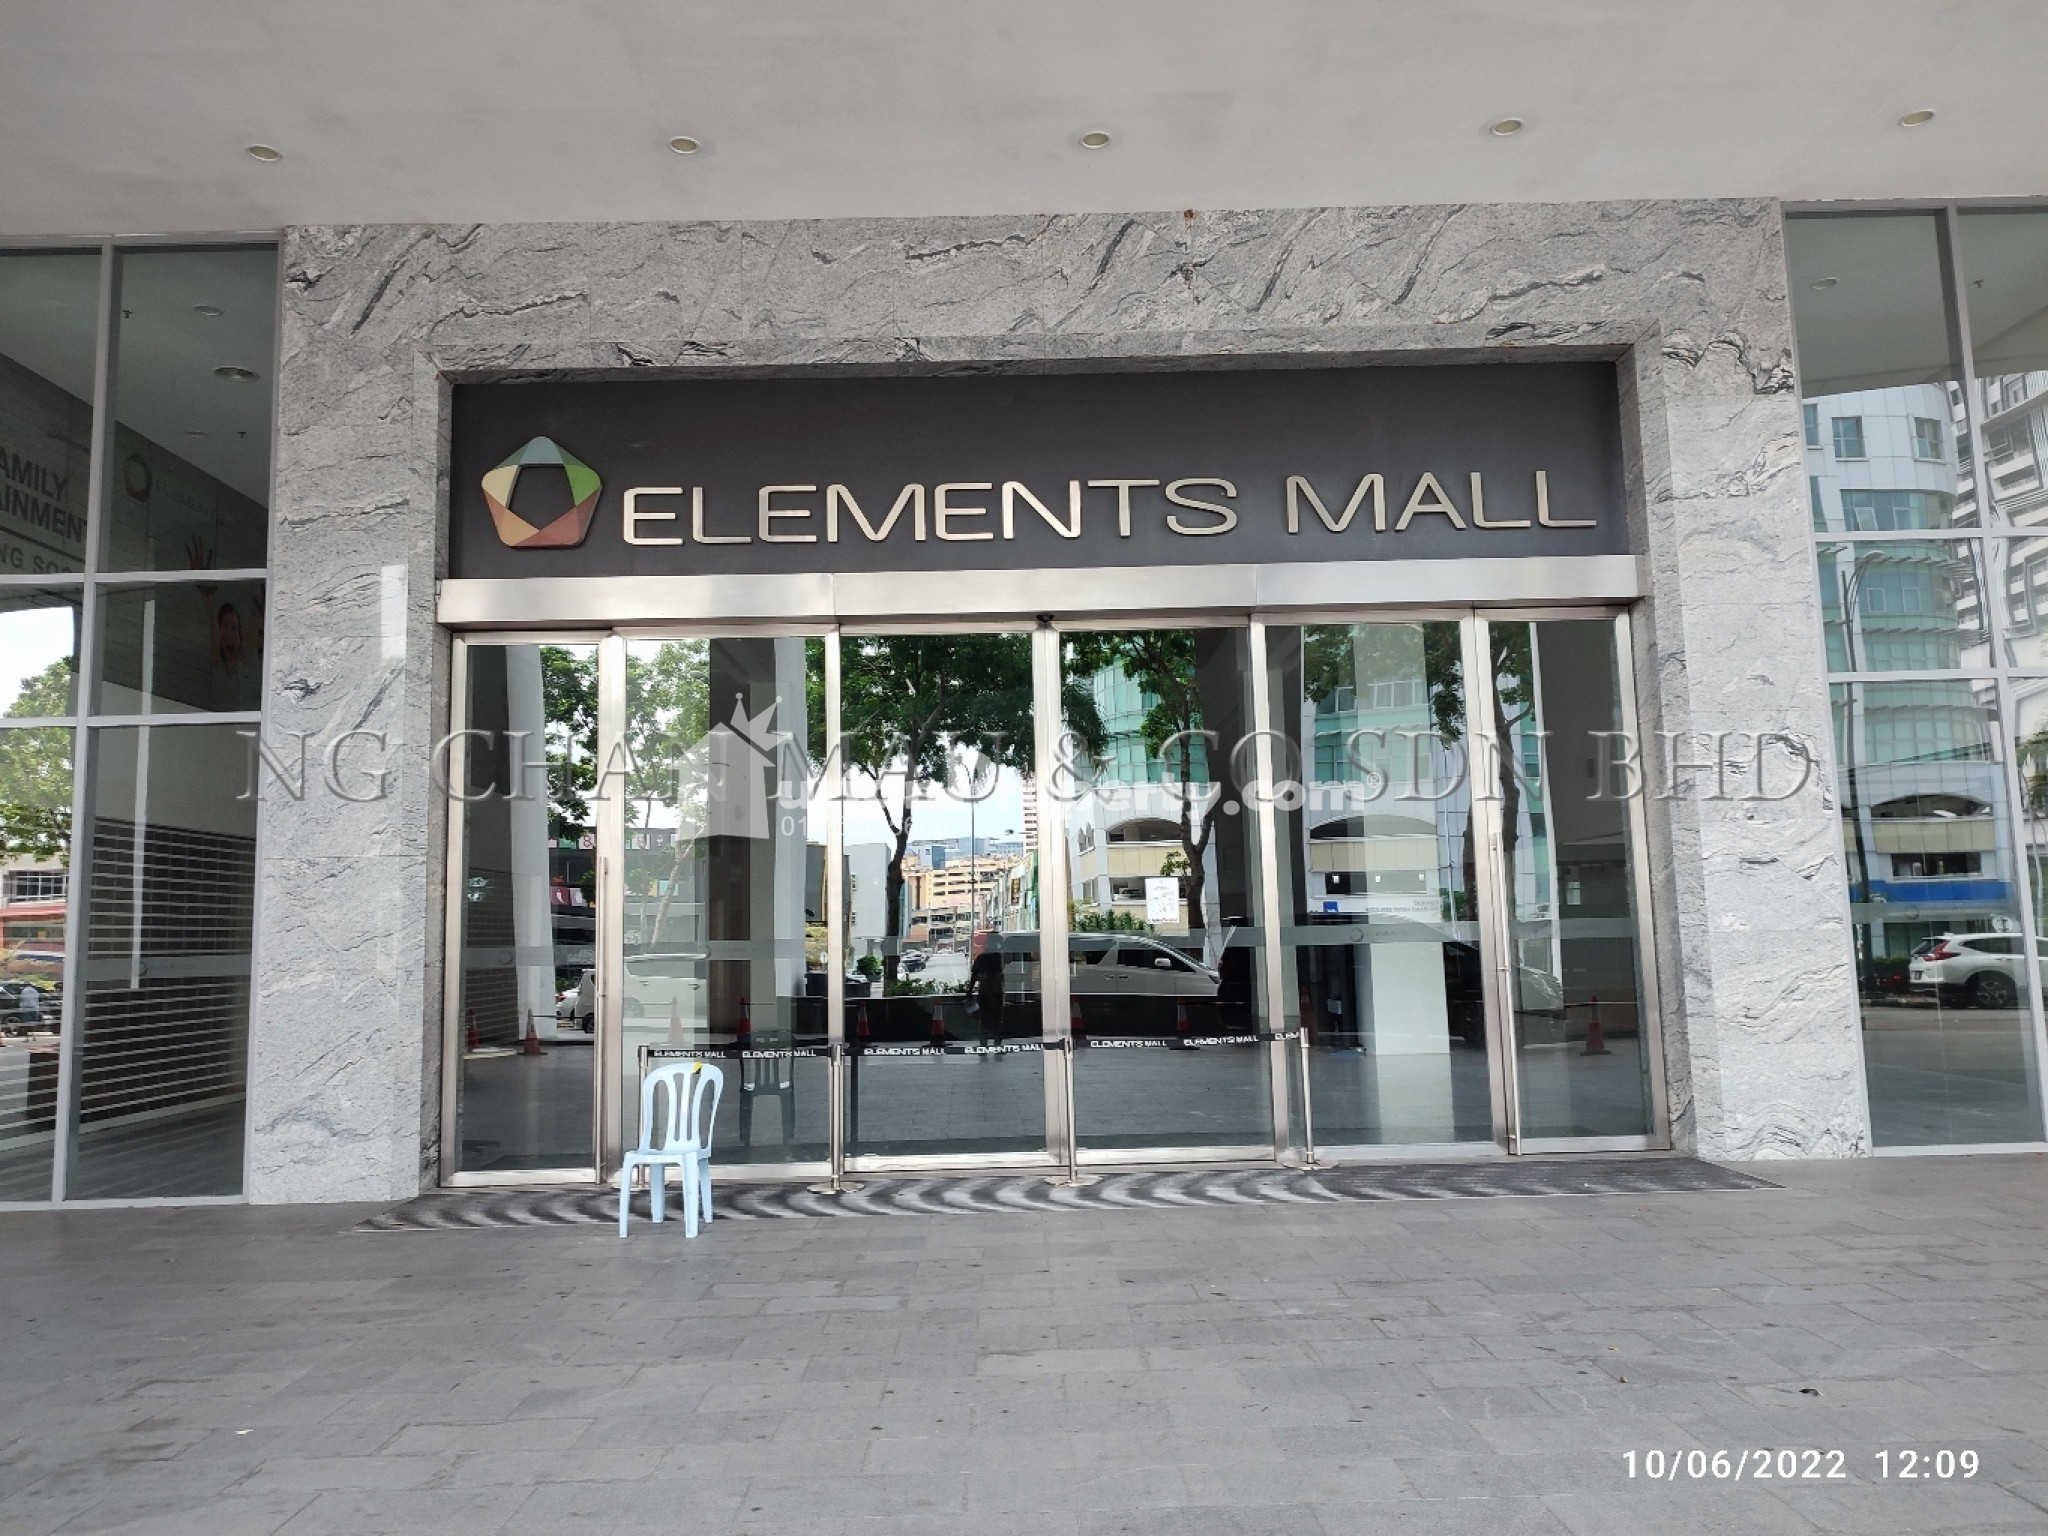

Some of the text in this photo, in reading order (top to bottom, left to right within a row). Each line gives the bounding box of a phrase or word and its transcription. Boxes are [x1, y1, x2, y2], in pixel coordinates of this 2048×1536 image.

[0, 484, 87, 544] INMEN
[622, 470, 1598, 547] ELEMENTS MALL
